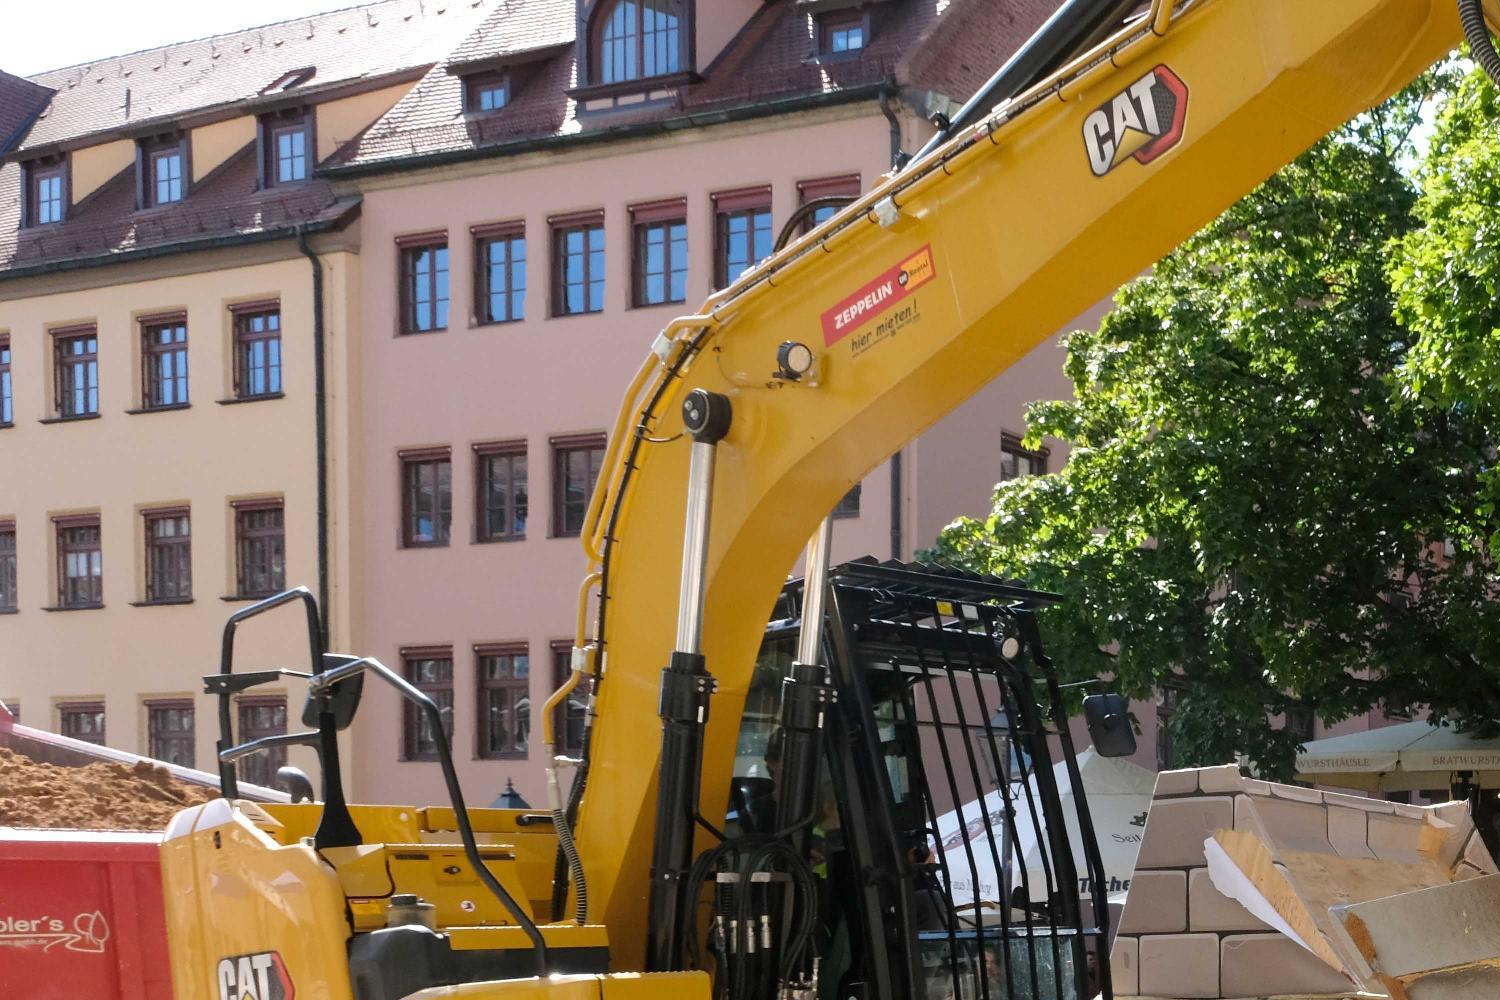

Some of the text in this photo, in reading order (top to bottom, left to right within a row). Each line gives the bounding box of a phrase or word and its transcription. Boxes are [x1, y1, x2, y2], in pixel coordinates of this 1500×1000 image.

[1083, 71, 1161, 175] CAT
[834, 280, 893, 330] ZEPPELIN
[851, 332, 872, 353] hier
